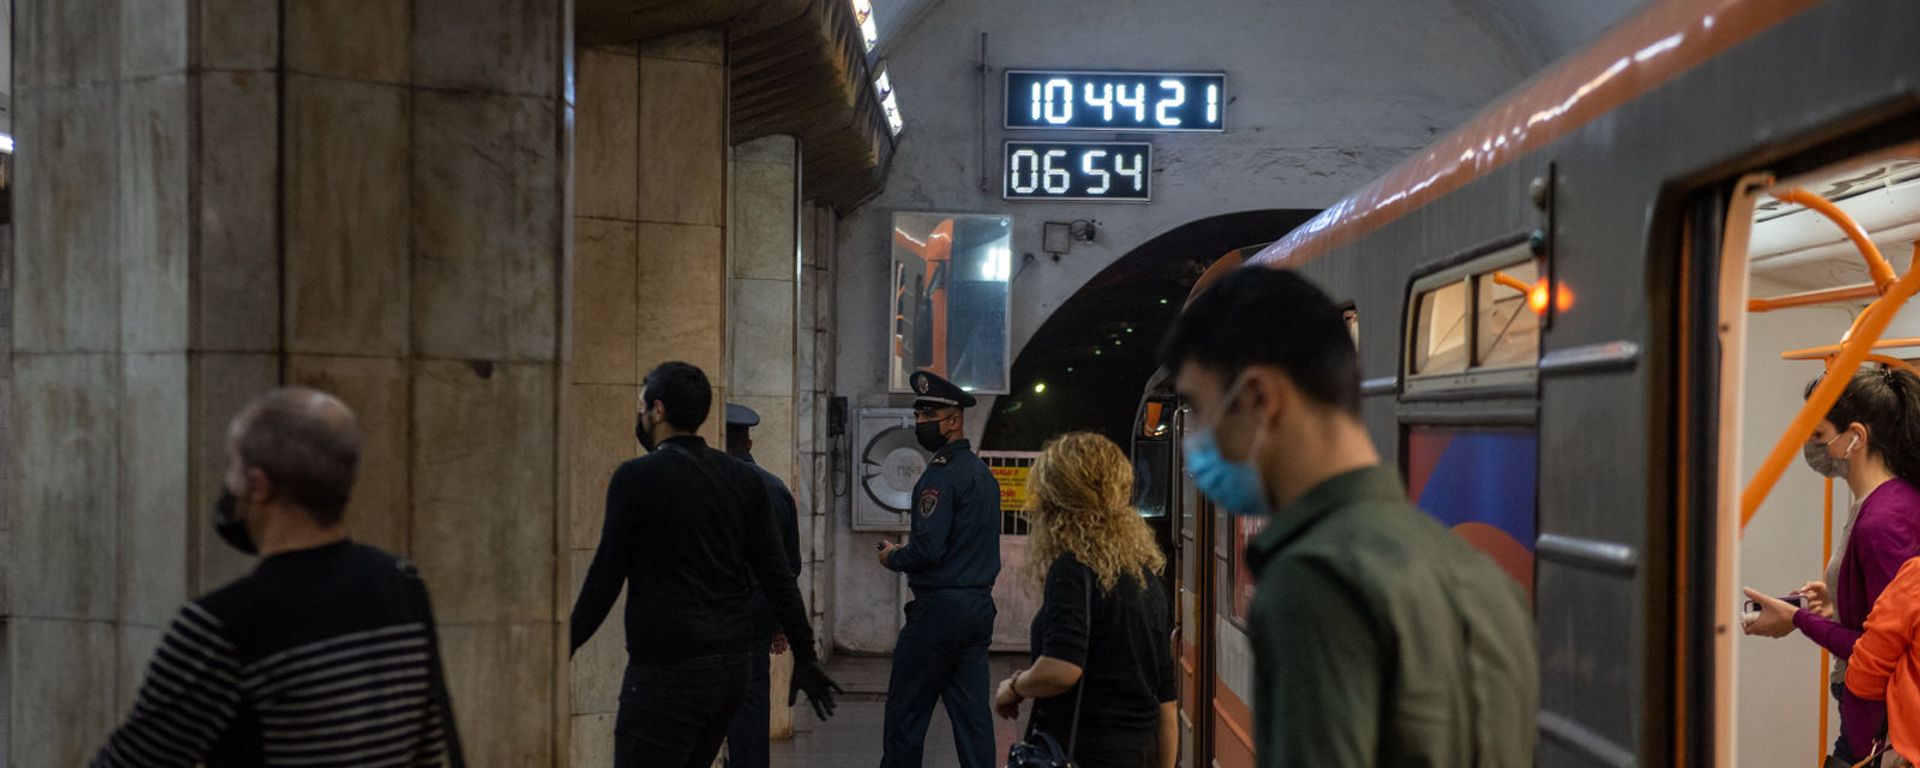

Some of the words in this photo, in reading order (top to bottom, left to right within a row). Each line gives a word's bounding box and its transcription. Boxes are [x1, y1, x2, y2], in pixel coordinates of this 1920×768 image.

[1032, 78, 1073, 124] 10
[1084, 82, 1145, 122] 44
[1011, 149, 1070, 194] 06
[1082, 150, 1143, 194] 54
